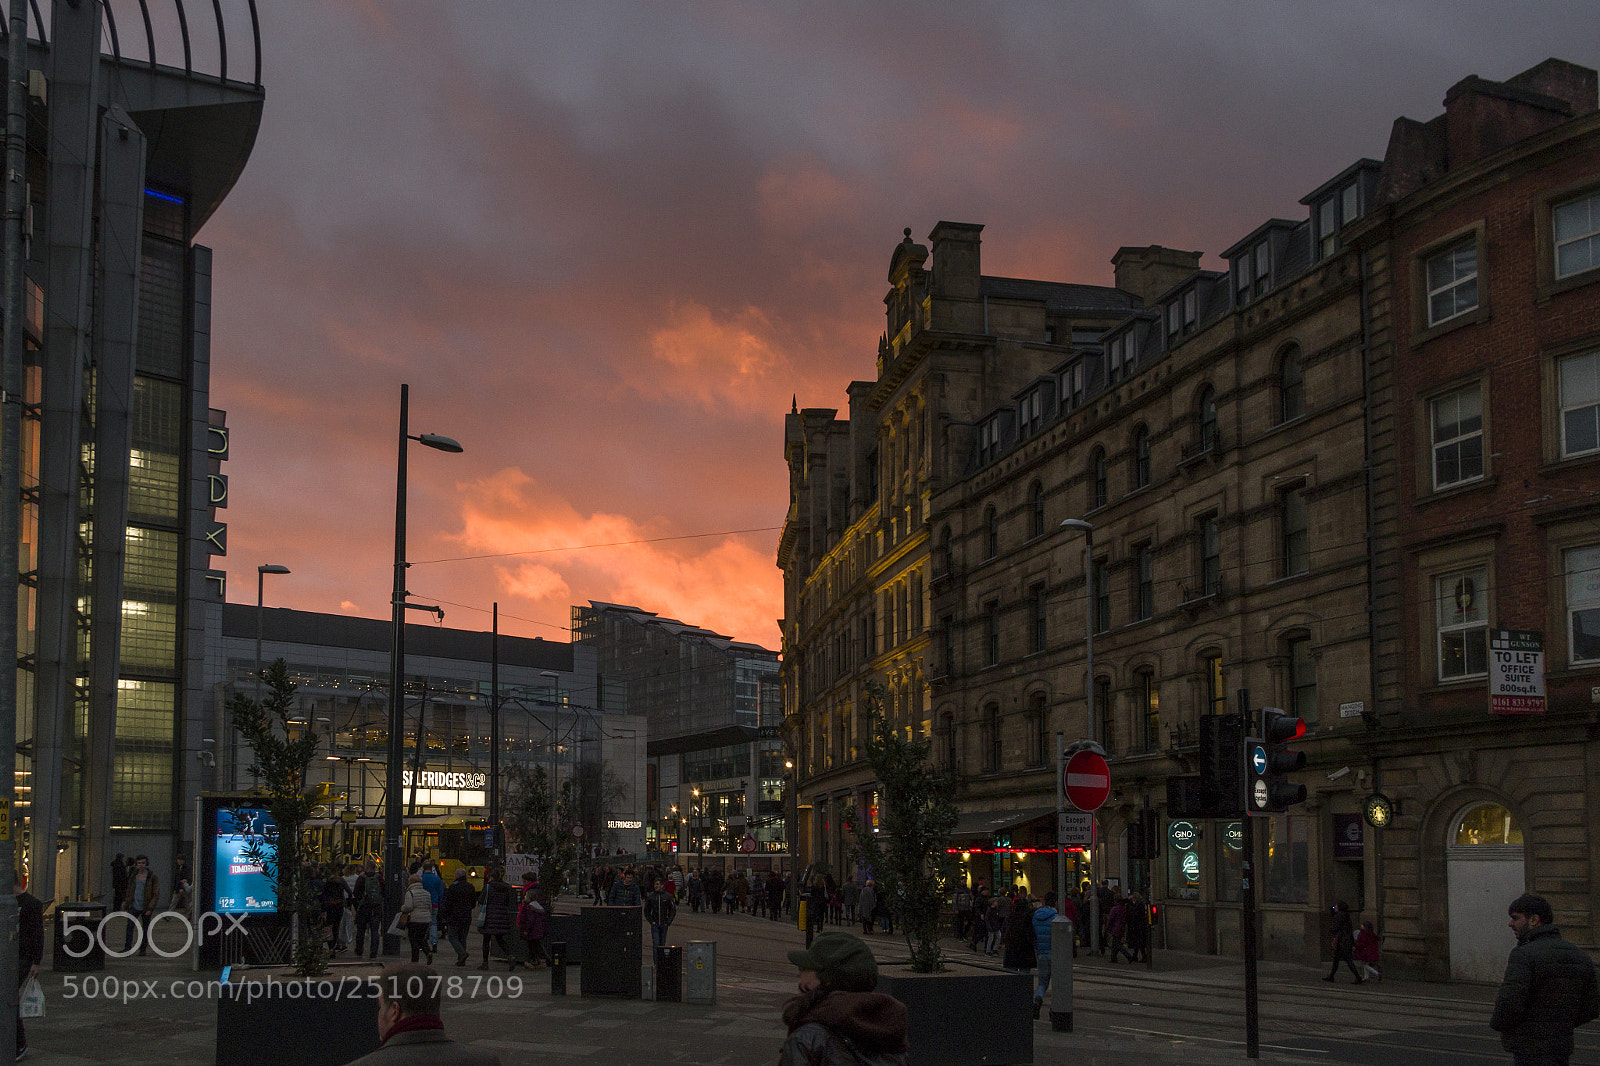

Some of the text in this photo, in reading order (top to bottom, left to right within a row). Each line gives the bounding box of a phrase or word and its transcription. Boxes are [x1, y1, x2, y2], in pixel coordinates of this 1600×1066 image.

[1495, 652, 1538, 664] TO LET
[1501, 665, 1534, 674] OFFICE
[1505, 674, 1531, 682] SUITE
[1493, 698, 1510, 706] 0161
[1512, 698, 1525, 707] 833
[1065, 816, 1086, 824] Except
[1066, 834, 1084, 842] cycles
[1174, 830, 1193, 838] GINO
